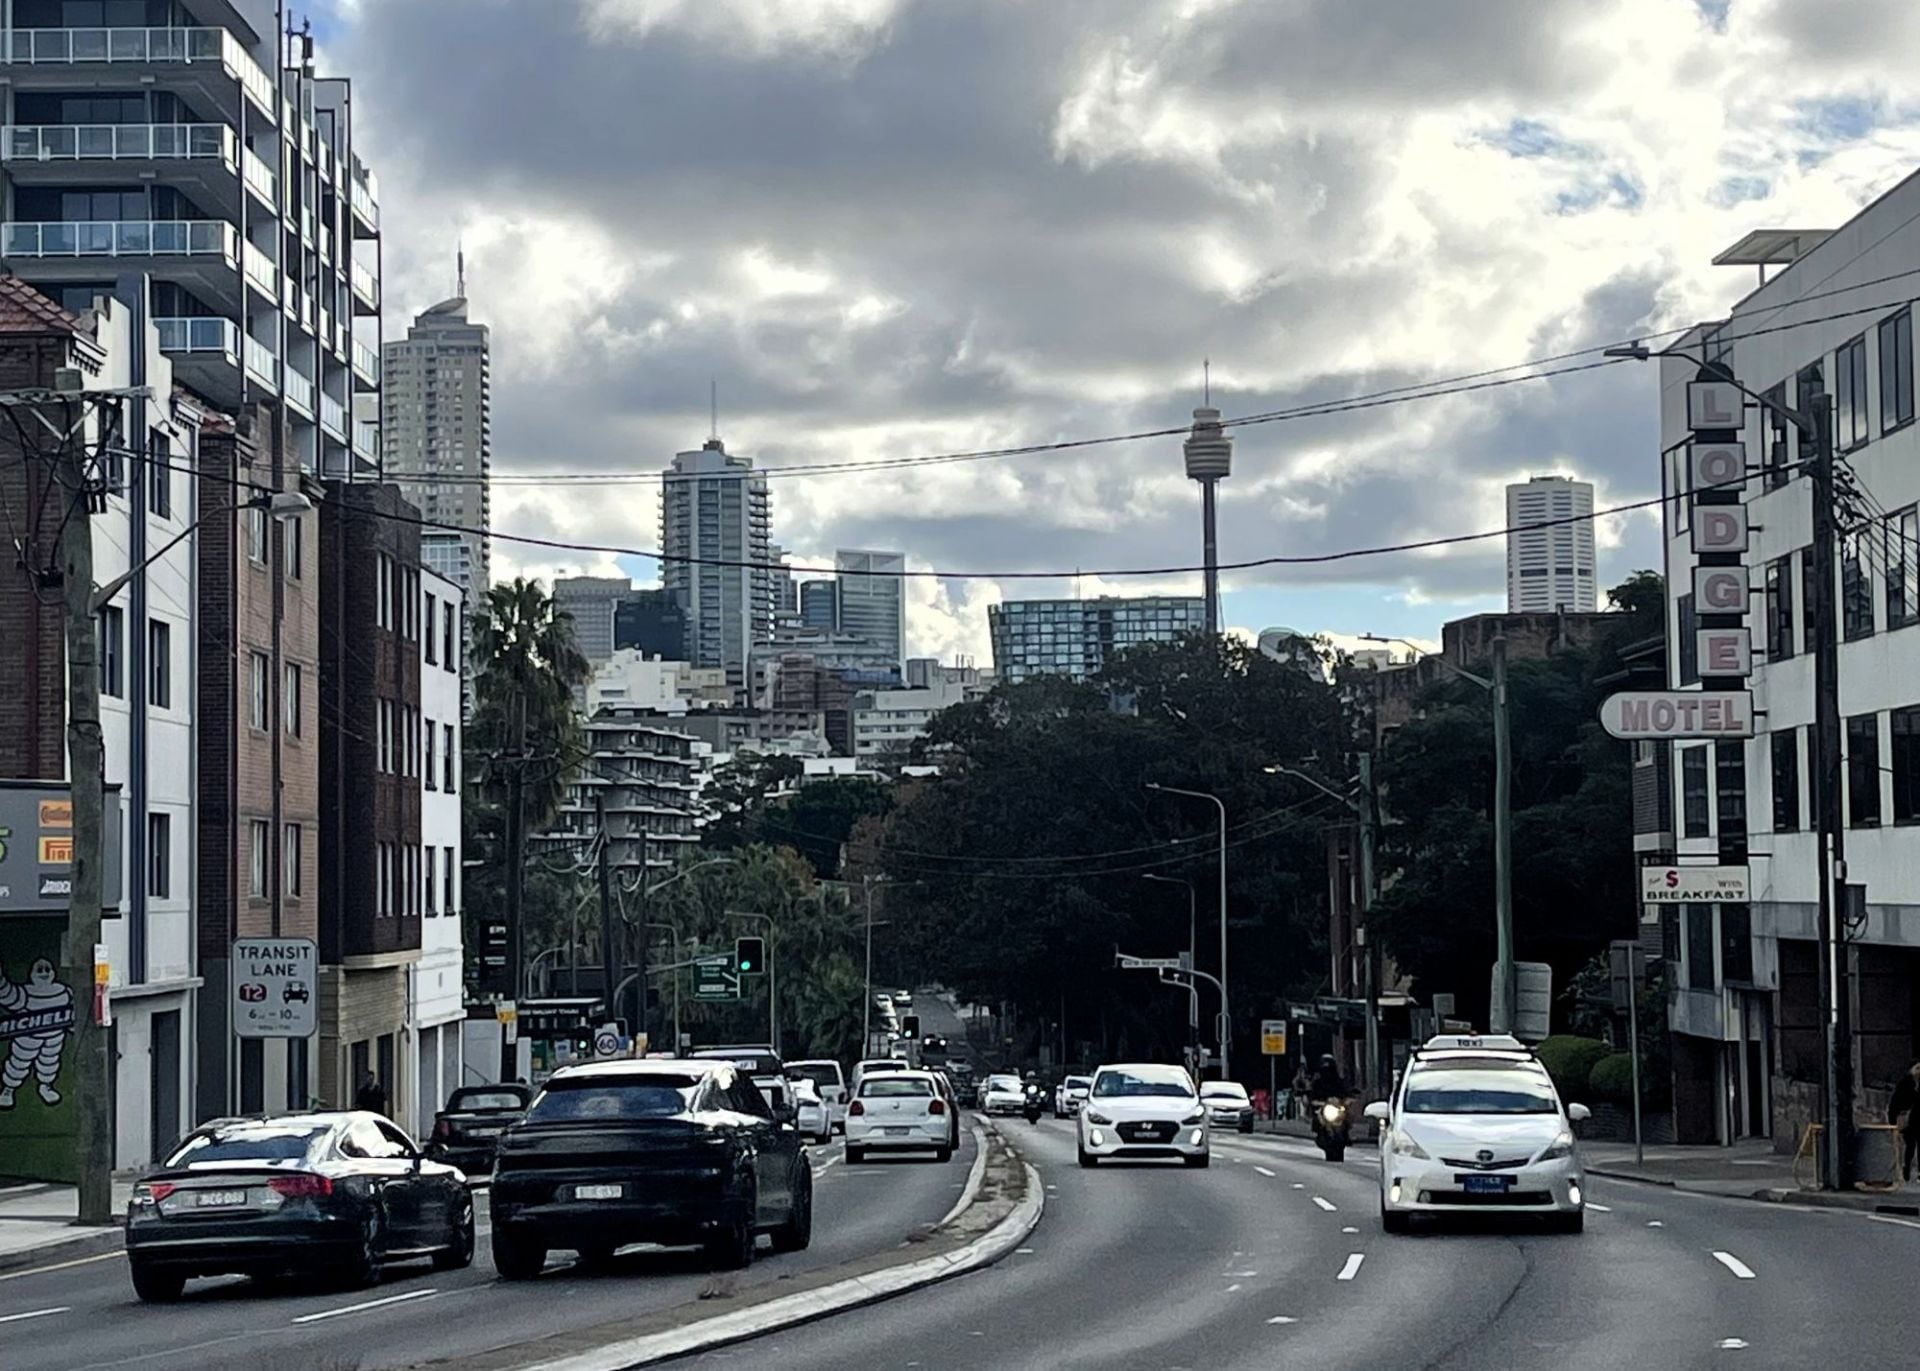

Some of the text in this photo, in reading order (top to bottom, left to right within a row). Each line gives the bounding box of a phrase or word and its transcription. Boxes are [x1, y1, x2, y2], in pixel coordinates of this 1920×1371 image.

[1699, 388, 1742, 671] LODGE
[1620, 699, 1744, 732] MOTEL
[1646, 890, 1745, 900] BREAKFAST
[239, 946, 310, 960] TRANSIT
[251, 964, 297, 977] LANE
[0, 1010, 71, 1033] MICHELI
[599, 1038, 615, 1050] 60
